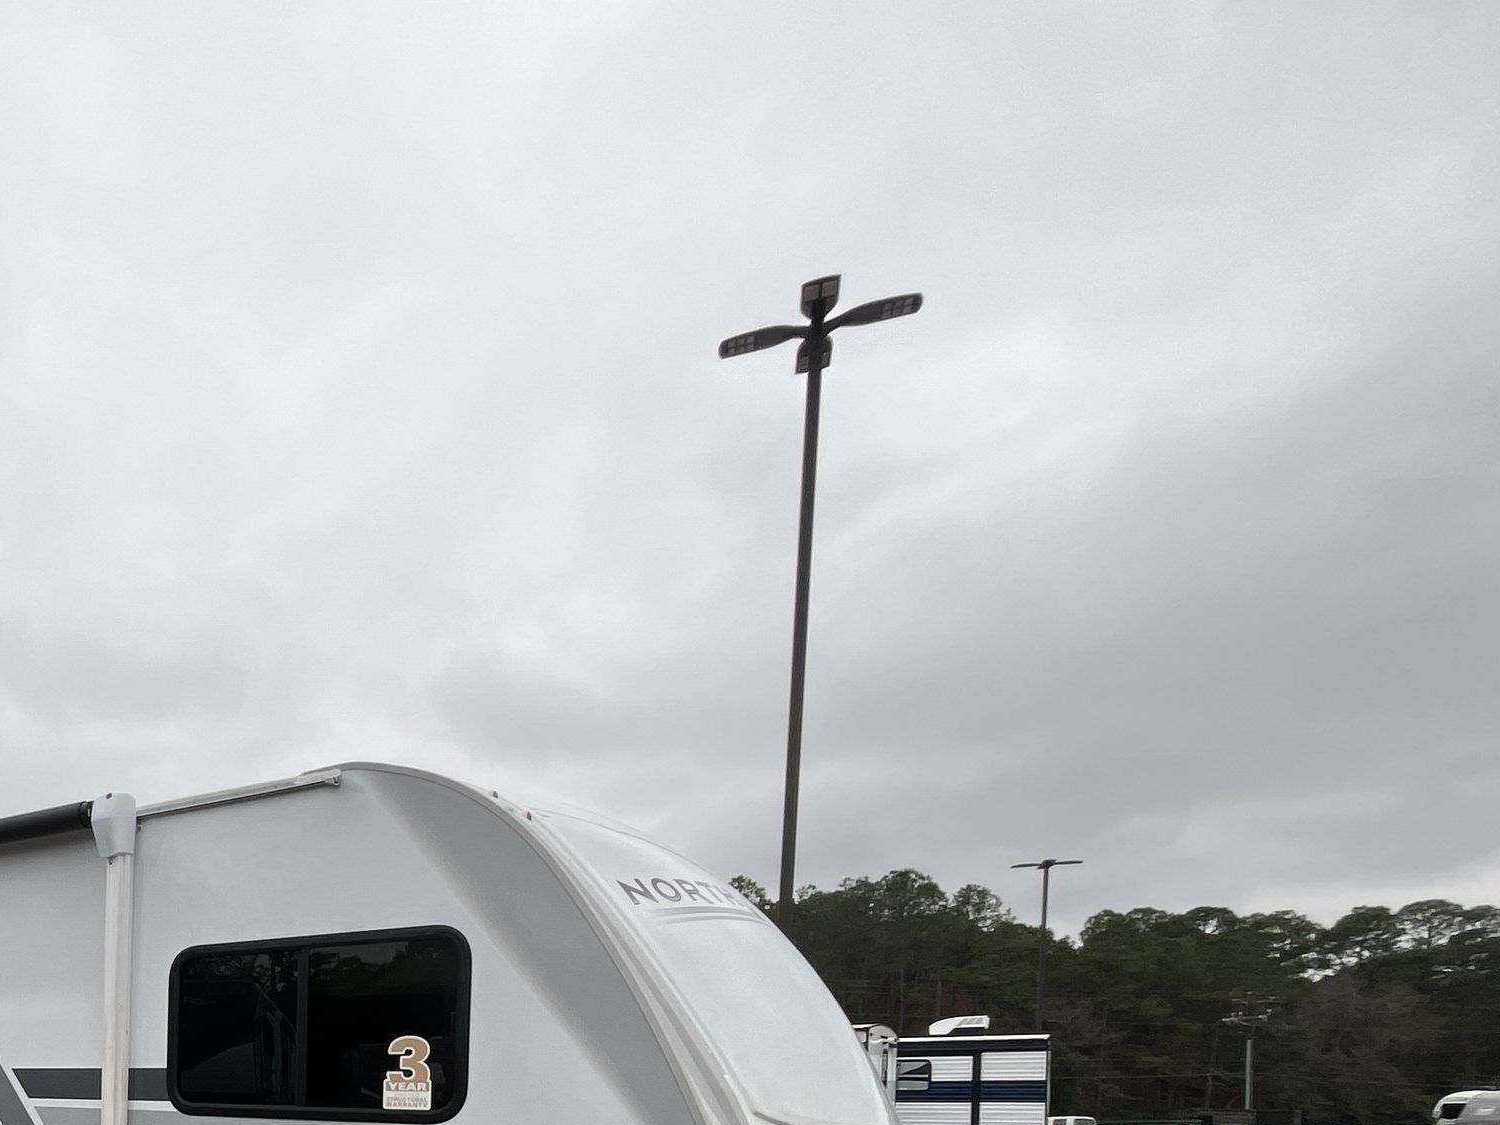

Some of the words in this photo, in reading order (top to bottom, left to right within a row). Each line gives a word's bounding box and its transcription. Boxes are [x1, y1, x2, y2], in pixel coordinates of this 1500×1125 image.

[615, 877, 744, 905] NORTH
[386, 1035, 431, 1082] 3
[388, 1081, 427, 1091] YEAR
